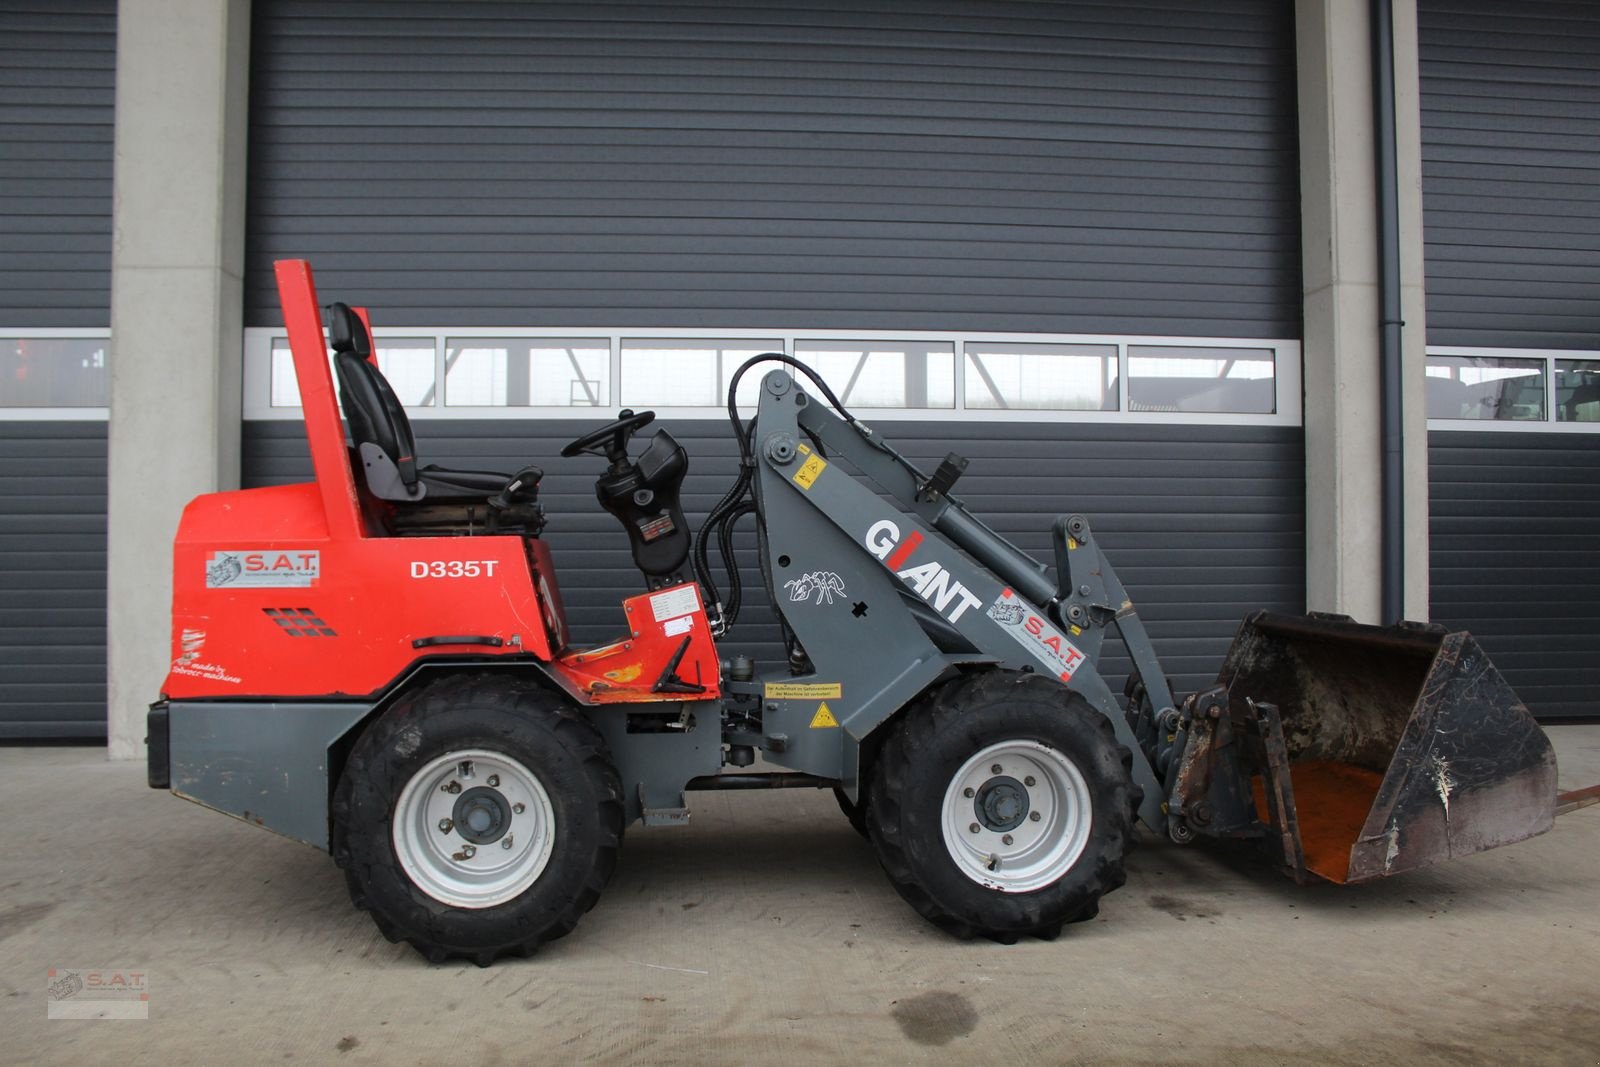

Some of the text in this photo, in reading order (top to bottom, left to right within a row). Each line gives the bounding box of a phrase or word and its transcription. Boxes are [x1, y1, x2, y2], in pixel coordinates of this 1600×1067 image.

[245, 554, 316, 570] S.A.T.
[410, 560, 499, 578] D335T
[1024, 616, 1083, 669] S.A.T.
